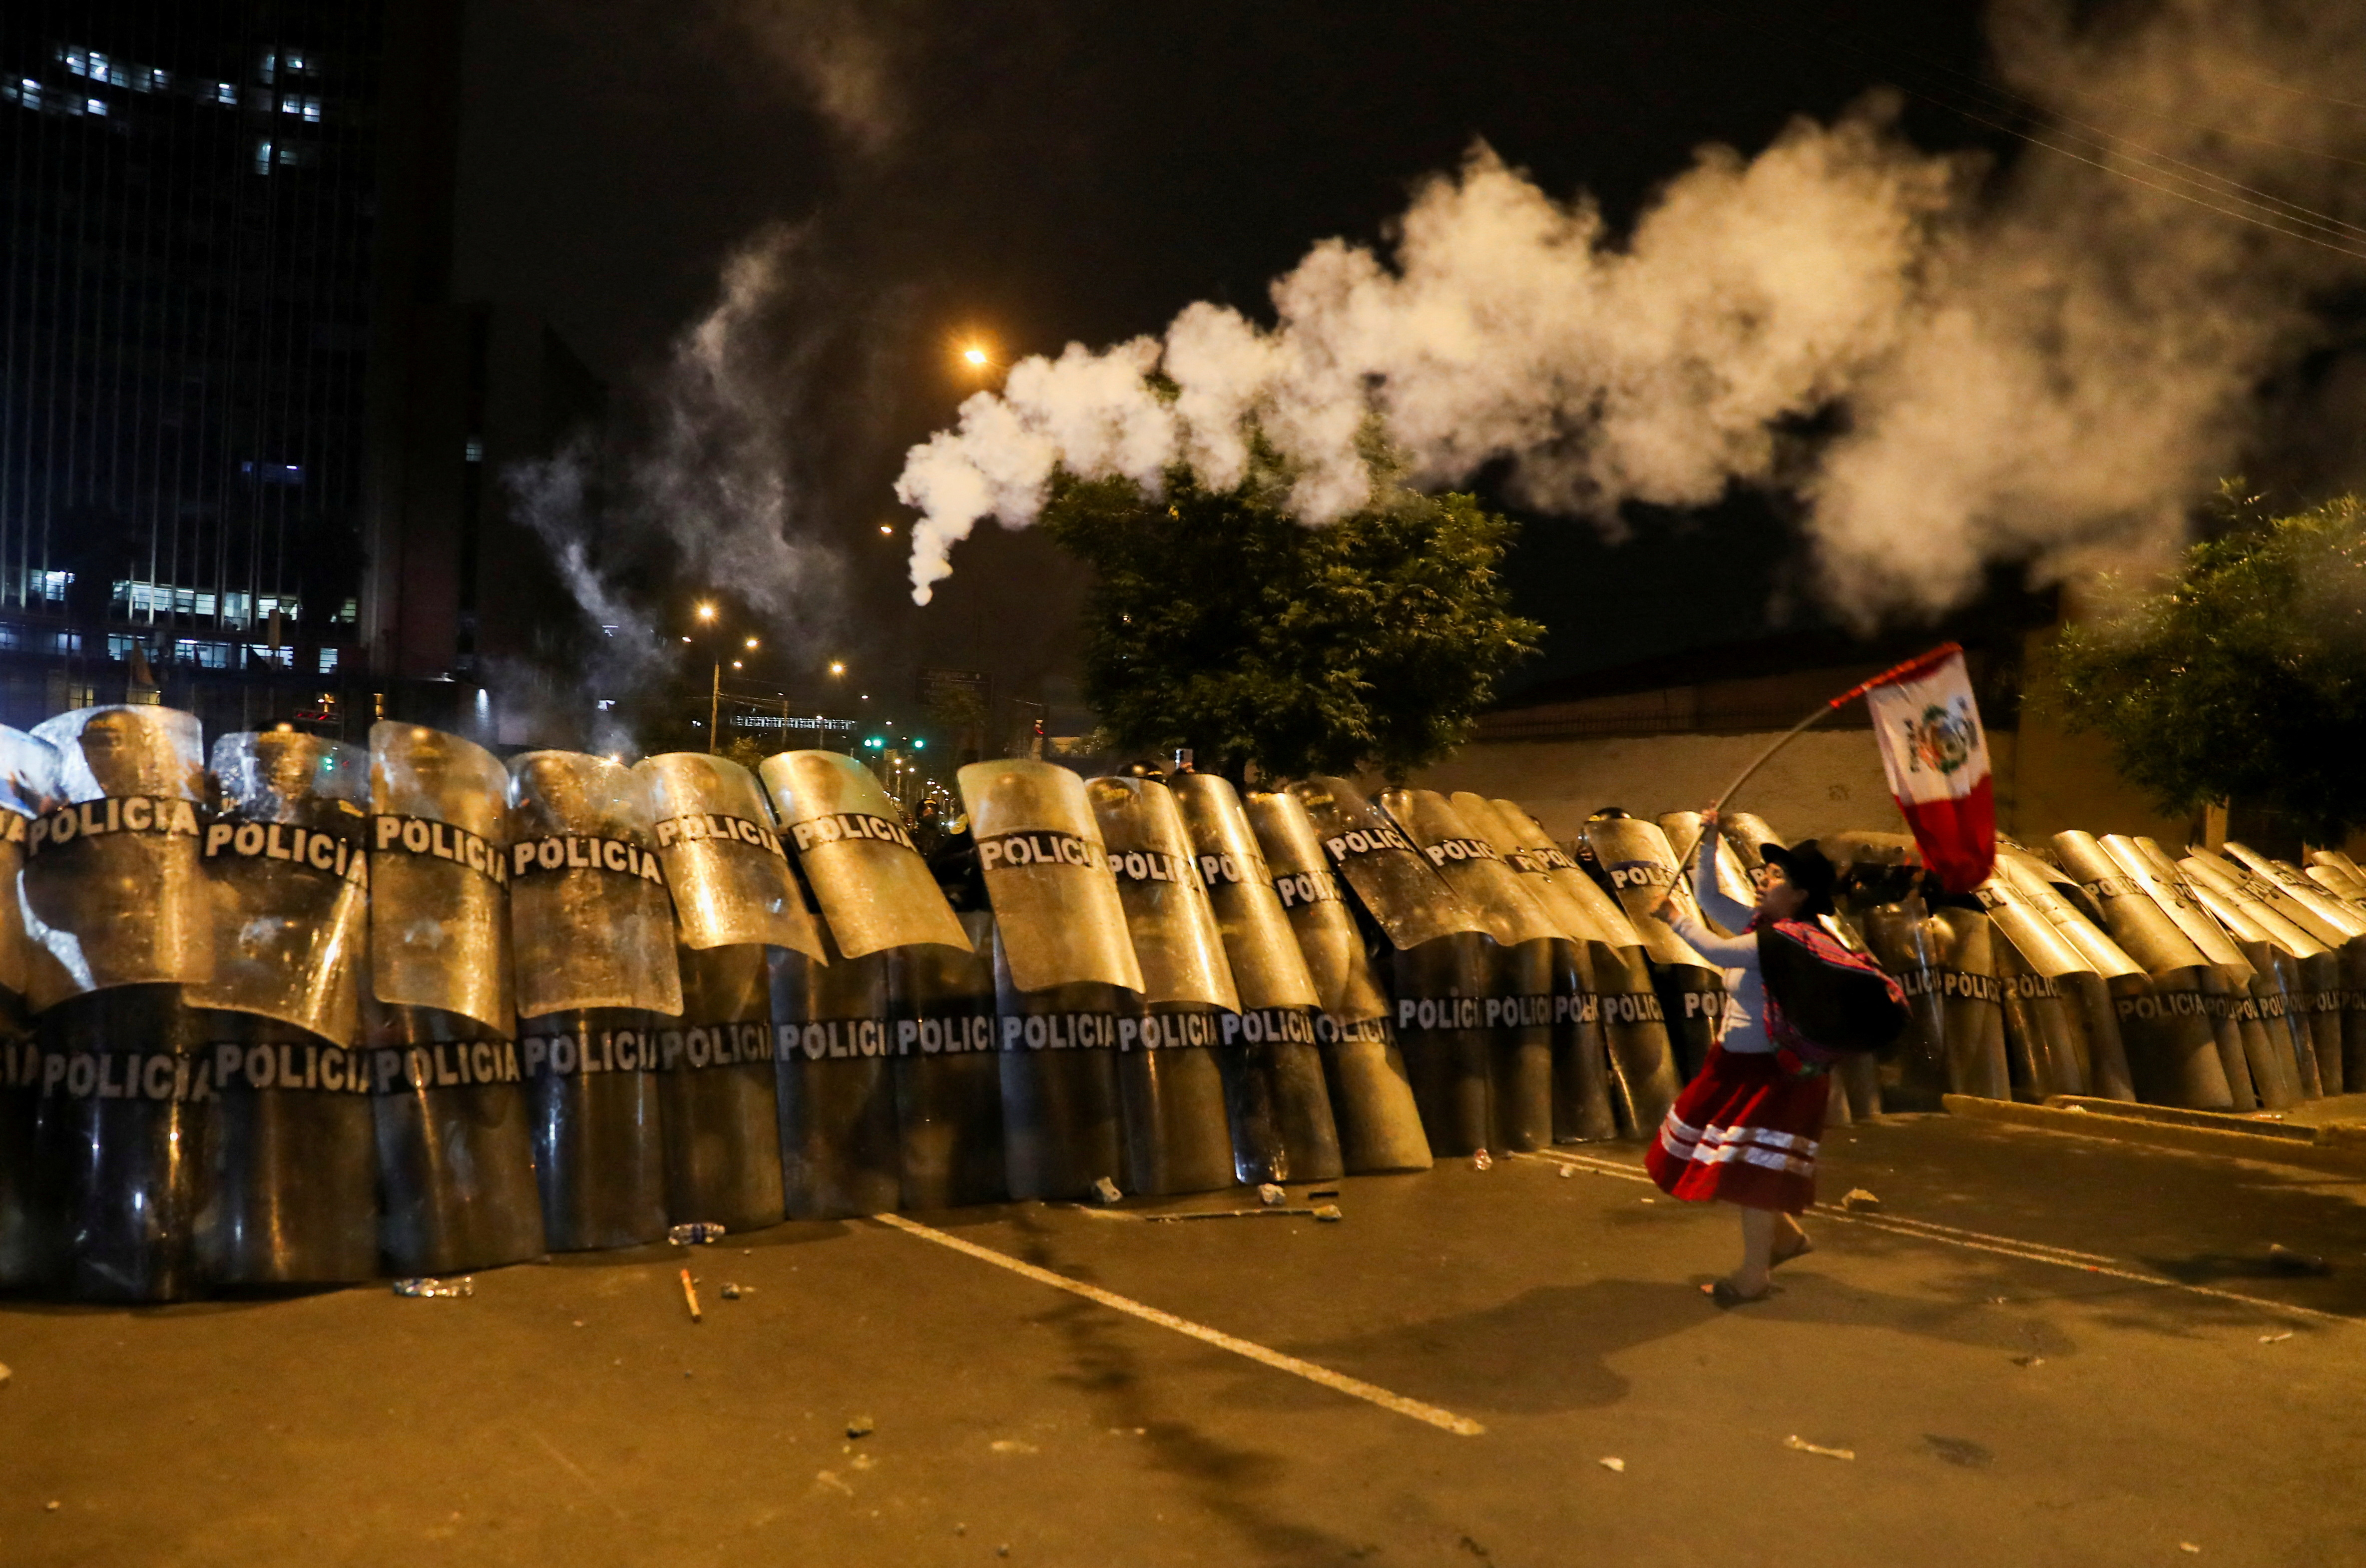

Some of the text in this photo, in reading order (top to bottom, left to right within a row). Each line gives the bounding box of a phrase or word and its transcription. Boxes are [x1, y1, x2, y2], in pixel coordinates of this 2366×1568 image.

[29, 797, 199, 856] POLICIA
[656, 815, 788, 860] POLICIA
[792, 814, 918, 852] POLICIA
[205, 822, 368, 888] POLICIA
[377, 816, 508, 888] POLICIA
[514, 837, 663, 885] POLICIA
[2117, 993, 2206, 1022] POLICIA
[1003, 1014, 1115, 1051] POLICIA
[375, 1042, 521, 1093] POLICIA
